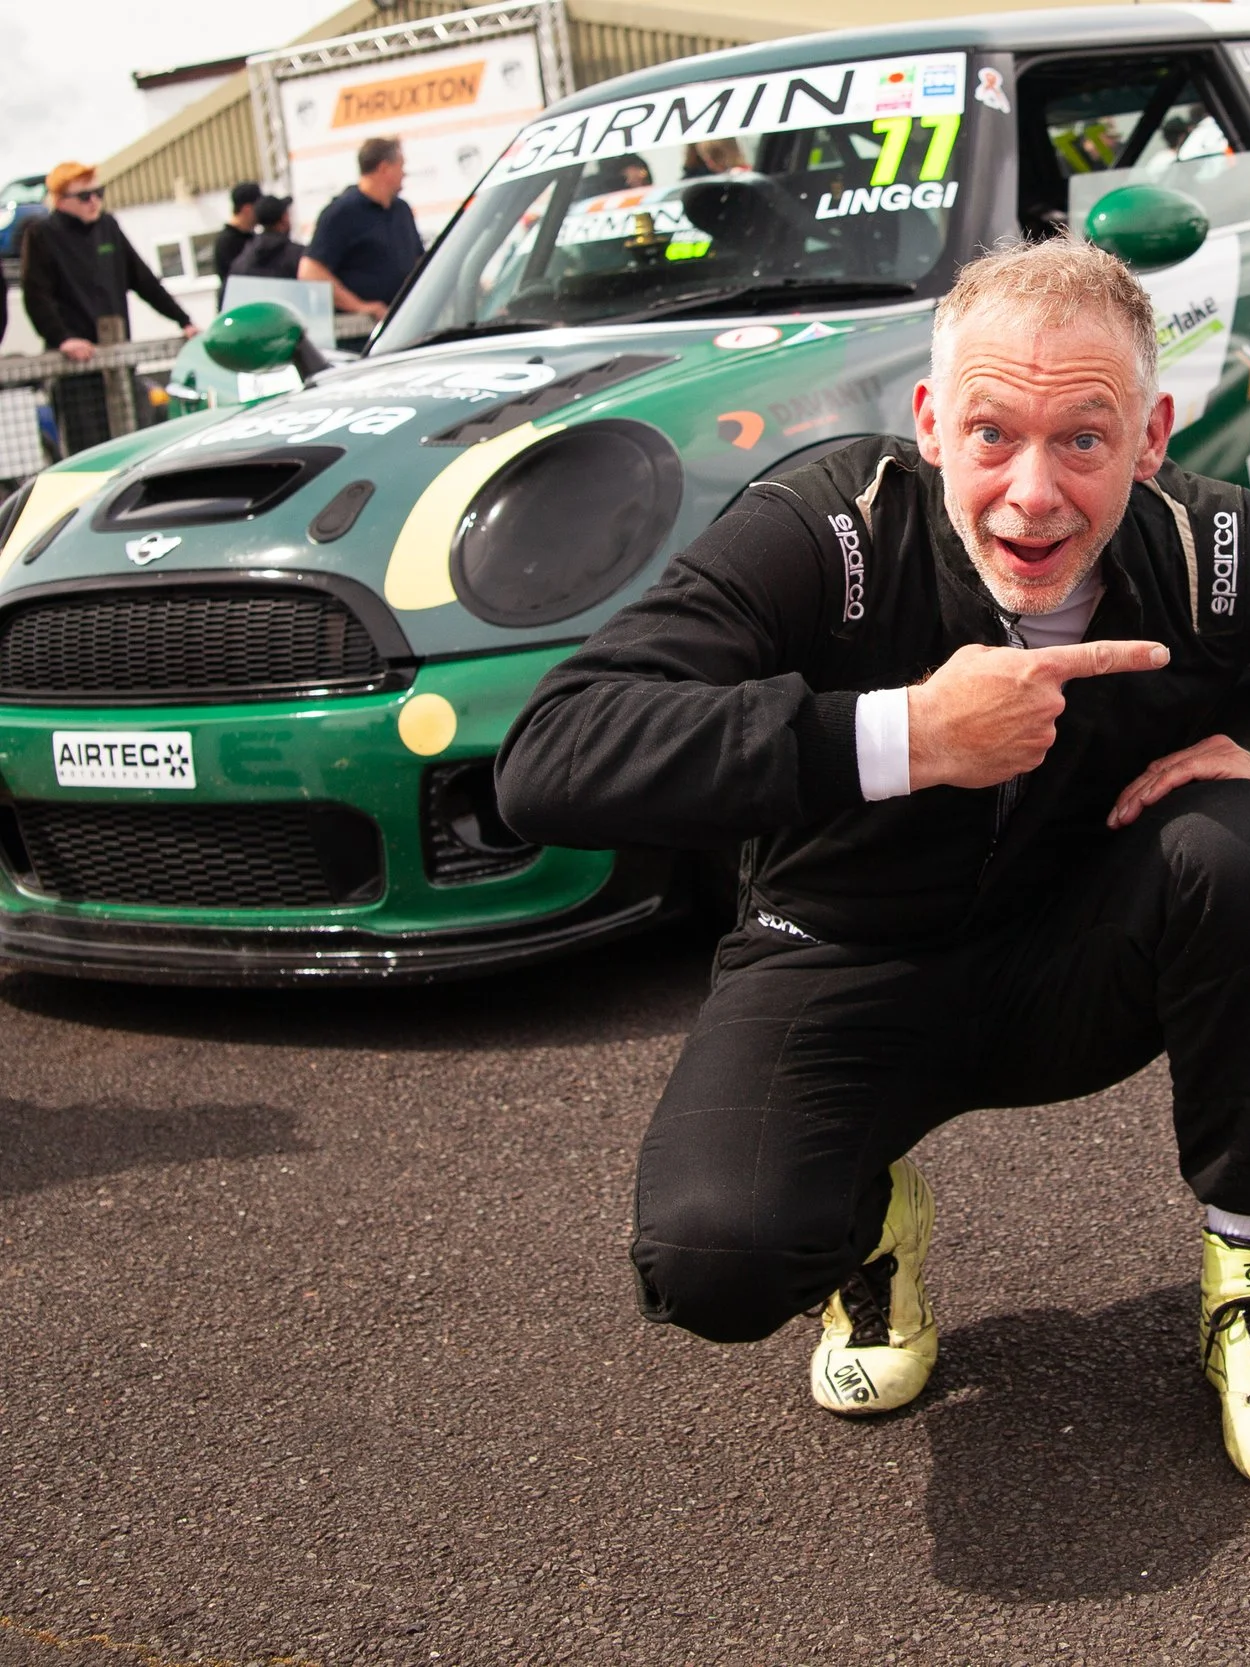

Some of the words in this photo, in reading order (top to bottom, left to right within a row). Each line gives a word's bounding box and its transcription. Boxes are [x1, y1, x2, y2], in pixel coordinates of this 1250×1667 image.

[341, 75, 477, 121] THRUXTON
[508, 70, 855, 173] GARMIN
[872, 114, 960, 186] 77
[815, 181, 959, 220] LINGGI
[60, 743, 159, 767] AIRTEC
[833, 1364, 870, 1404] OMP
